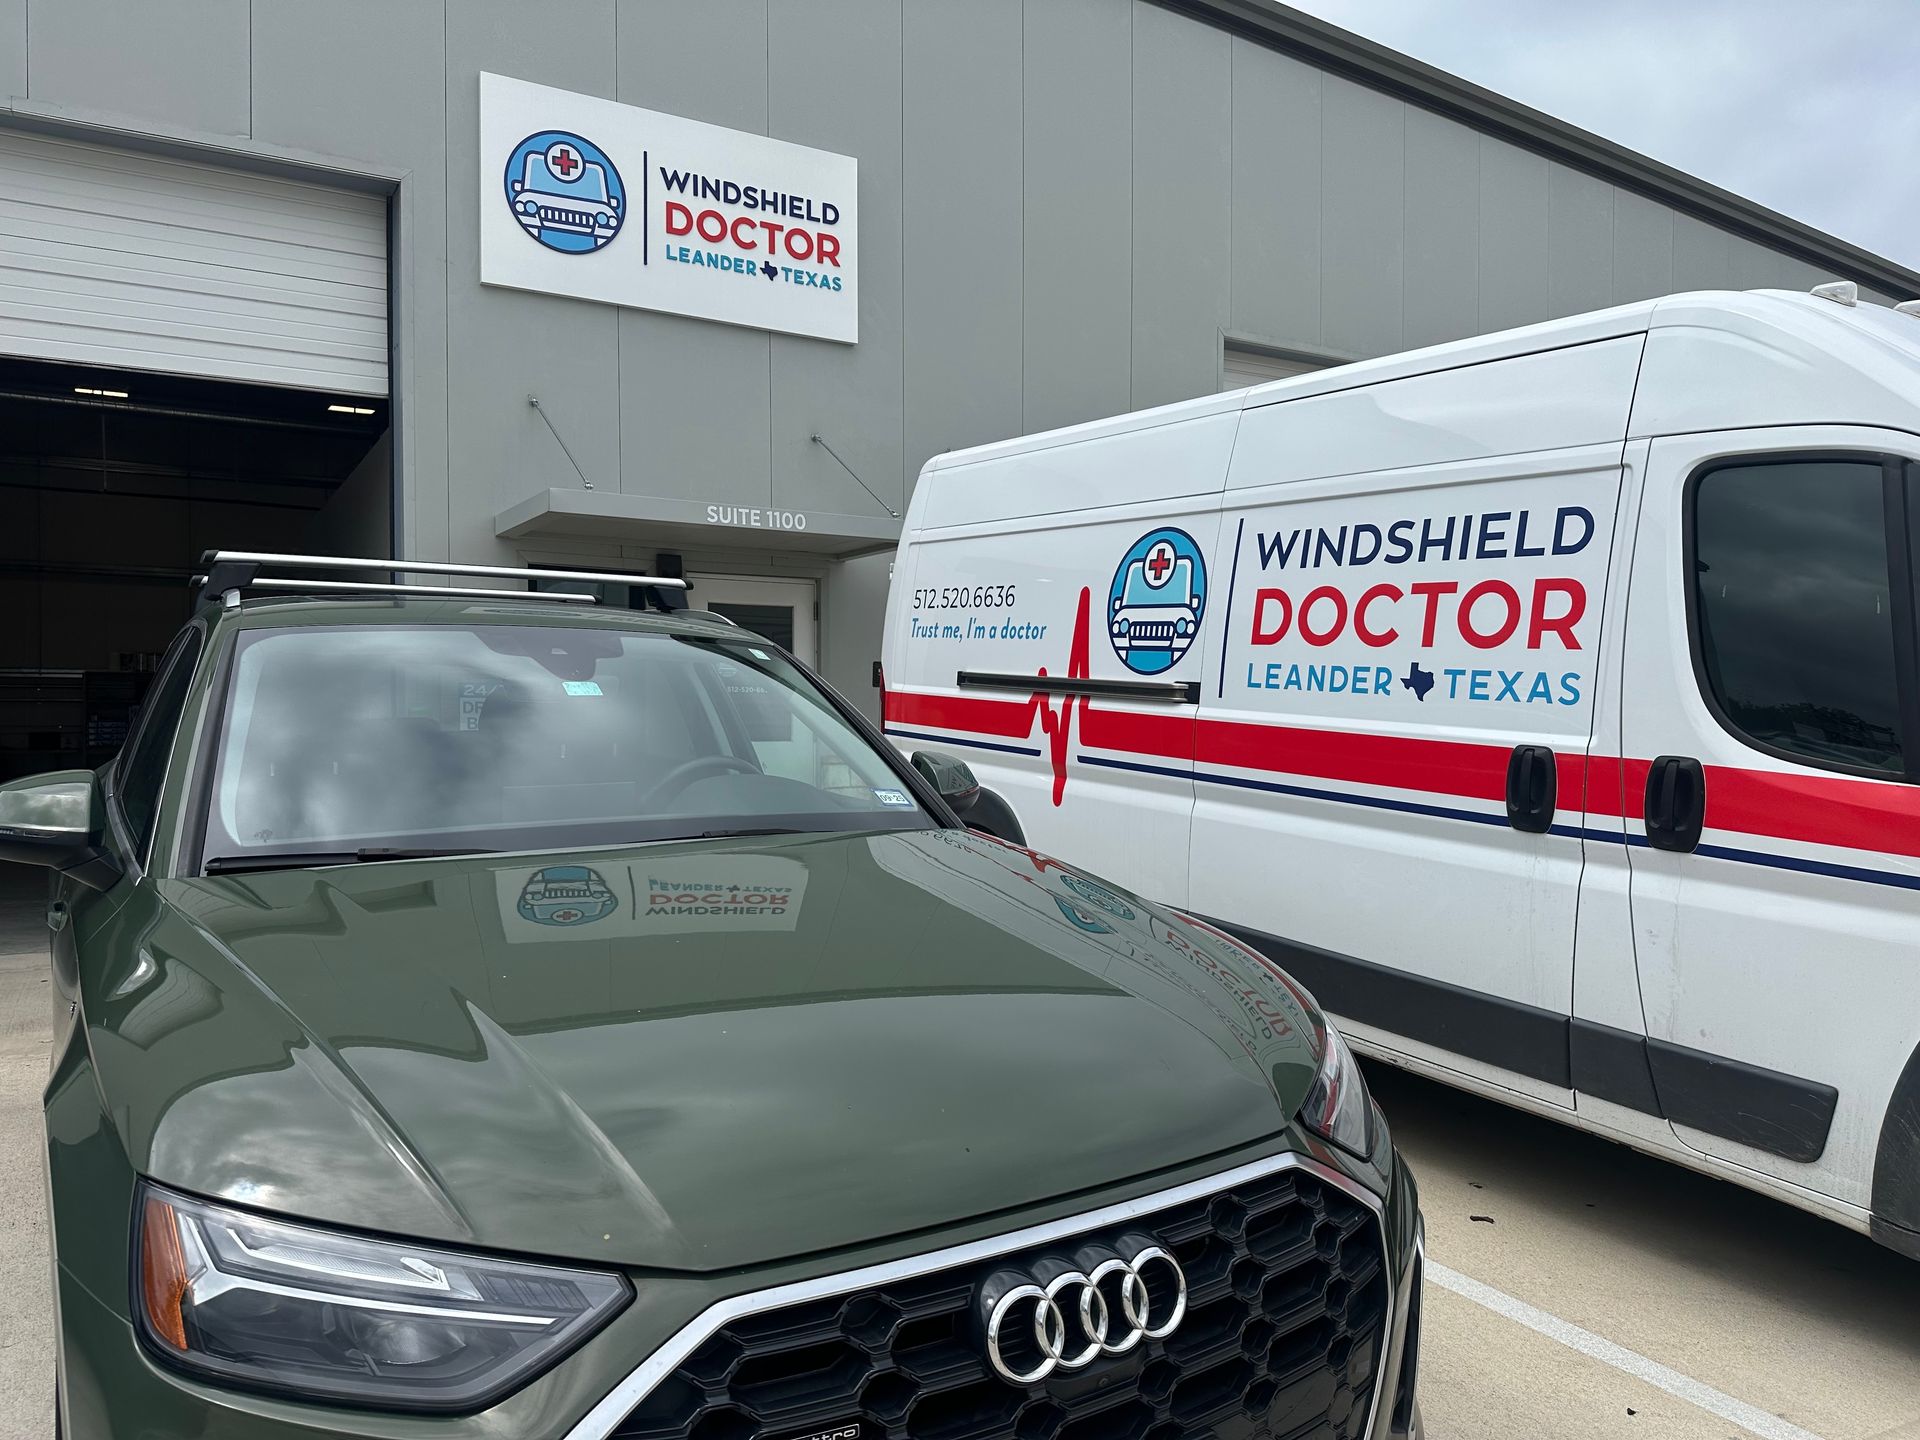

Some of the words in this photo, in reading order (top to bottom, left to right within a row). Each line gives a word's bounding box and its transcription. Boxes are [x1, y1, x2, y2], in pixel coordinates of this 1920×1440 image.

[660, 166, 840, 226] WINDSHIELD
[665, 201, 841, 268] DOCTOR
[665, 244, 757, 277] LEANDER
[780, 266, 842, 292] TEXAS
[707, 505, 760, 526] SUITE
[766, 511, 806, 530] 1100
[1257, 506, 1595, 571] WINDSHIELD
[913, 585, 1016, 610] 512.520.6636
[1250, 577, 1587, 650] DOCTOR
[911, 618, 938, 639] Trust
[942, 626, 963, 643] me,
[966, 617, 985, 639] I'm
[989, 626, 996, 639] a
[1000, 617, 1047, 640] doctor
[1247, 663, 1393, 697] LEANDER
[1444, 669, 1581, 706] TEXAS
